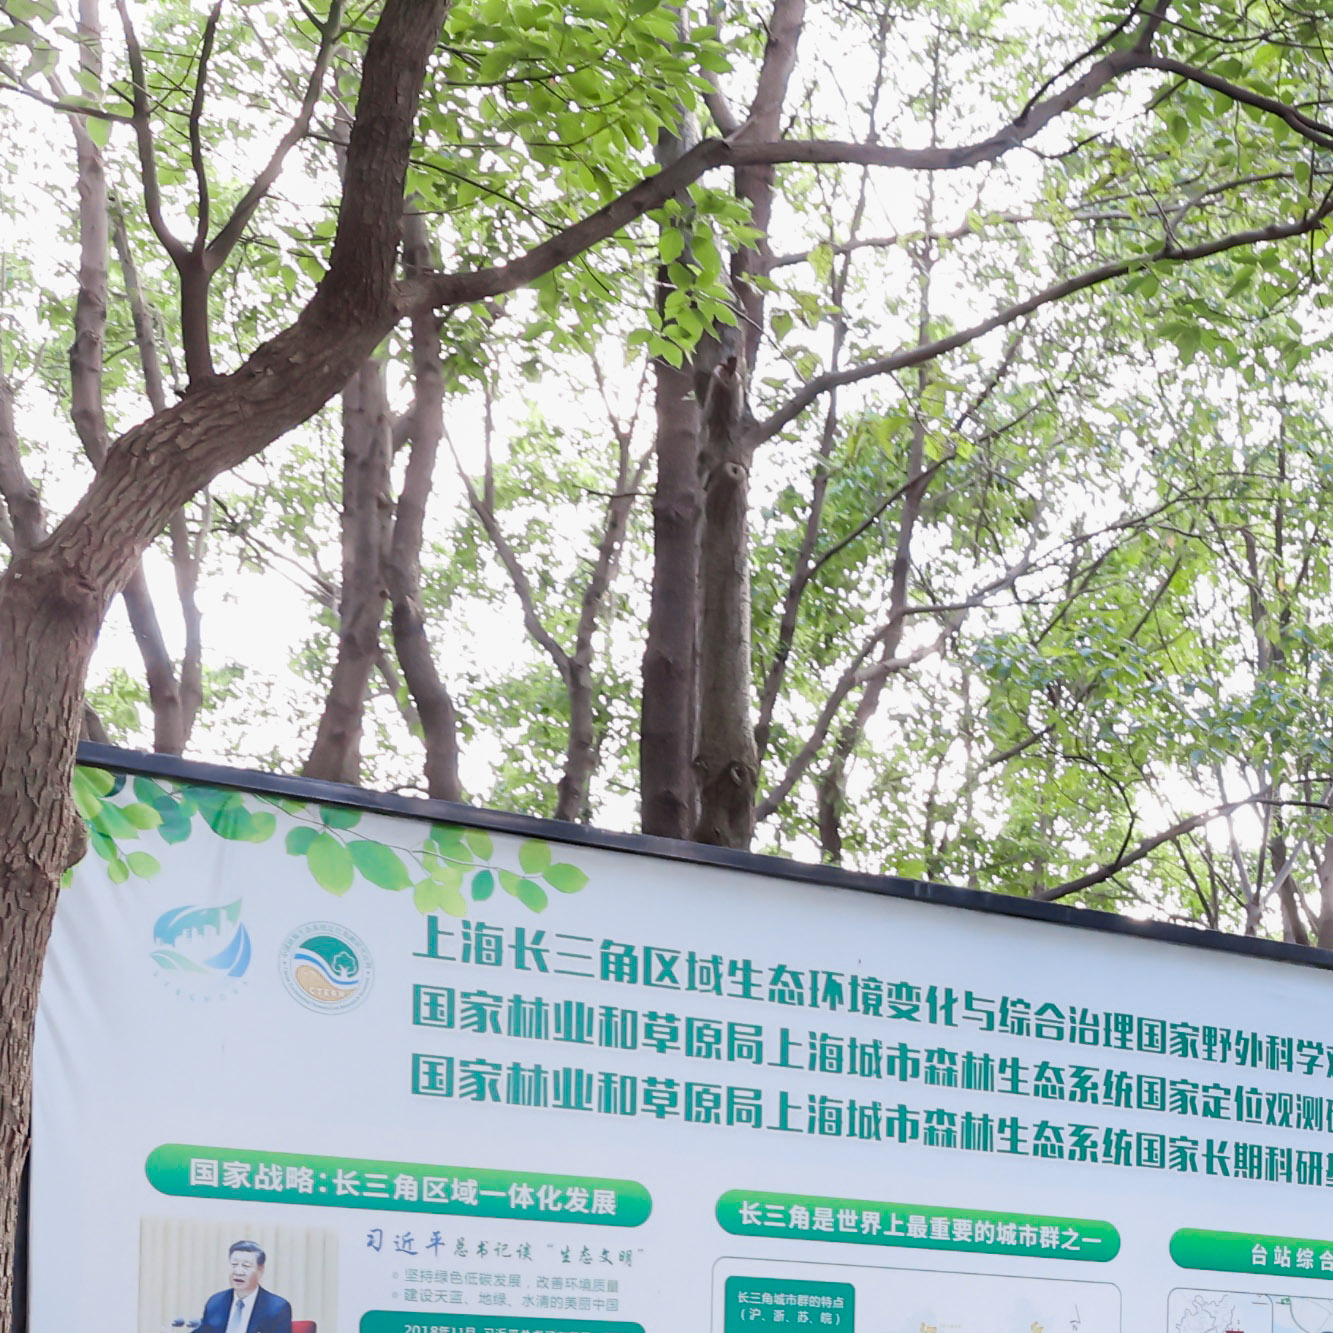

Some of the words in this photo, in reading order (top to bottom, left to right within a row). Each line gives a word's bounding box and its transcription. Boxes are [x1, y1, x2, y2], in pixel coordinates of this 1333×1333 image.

[739, 1200, 1103, 1253] 长三角是世界上最重要的城市群之一
[737, 1291, 844, 1308] 长三角城市群的特点
